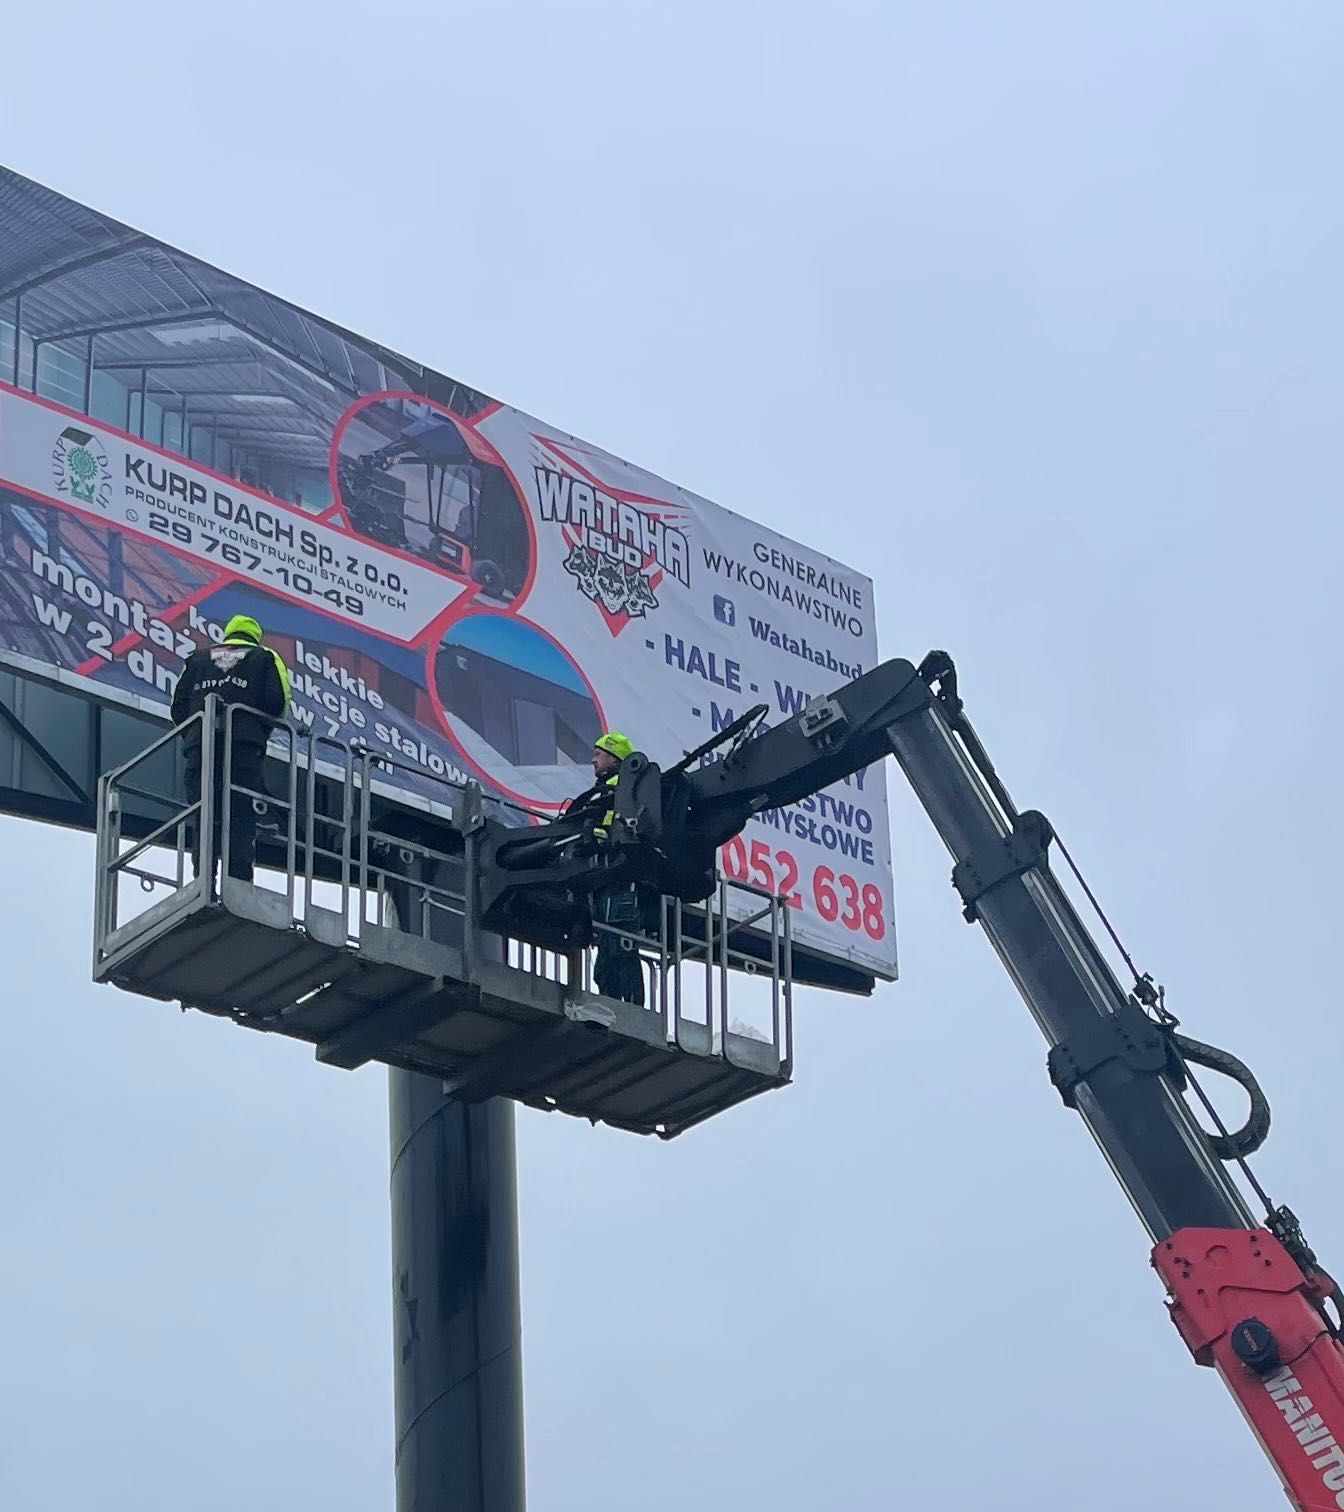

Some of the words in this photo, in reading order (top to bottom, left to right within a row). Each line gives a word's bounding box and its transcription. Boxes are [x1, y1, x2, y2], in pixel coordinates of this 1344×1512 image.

[52, 437, 68, 491] KURP
[96, 454, 113, 509] DACH
[125, 453, 207, 505] KURP
[214, 491, 294, 549] DACH
[300, 530, 340, 567] Sp.
[346, 556, 358, 576] z
[364, 563, 408, 596] o.o.
[125, 485, 216, 531] PRODUCENT
[219, 525, 318, 576] KONSTRUKCJI
[320, 565, 407, 612] STALOWYCH
[534, 466, 691, 589] WATAHA
[588, 528, 644, 570] BUD
[149, 512, 192, 544] 29
[200, 533, 364, 617] 767-10-49
[703, 548, 863, 637] WYKONAWSTWO
[753, 542, 862, 610] GENERALNE
[32, 549, 197, 661] montaż
[32, 594, 73, 635] w
[86, 621, 113, 662] 2
[295, 639, 385, 710] lekkie
[664, 633, 742, 694] HALE
[749, 616, 863, 680] Watahabud
[290, 699, 315, 728] w
[323, 715, 341, 738] 7
[812, 864, 886, 941] 638
